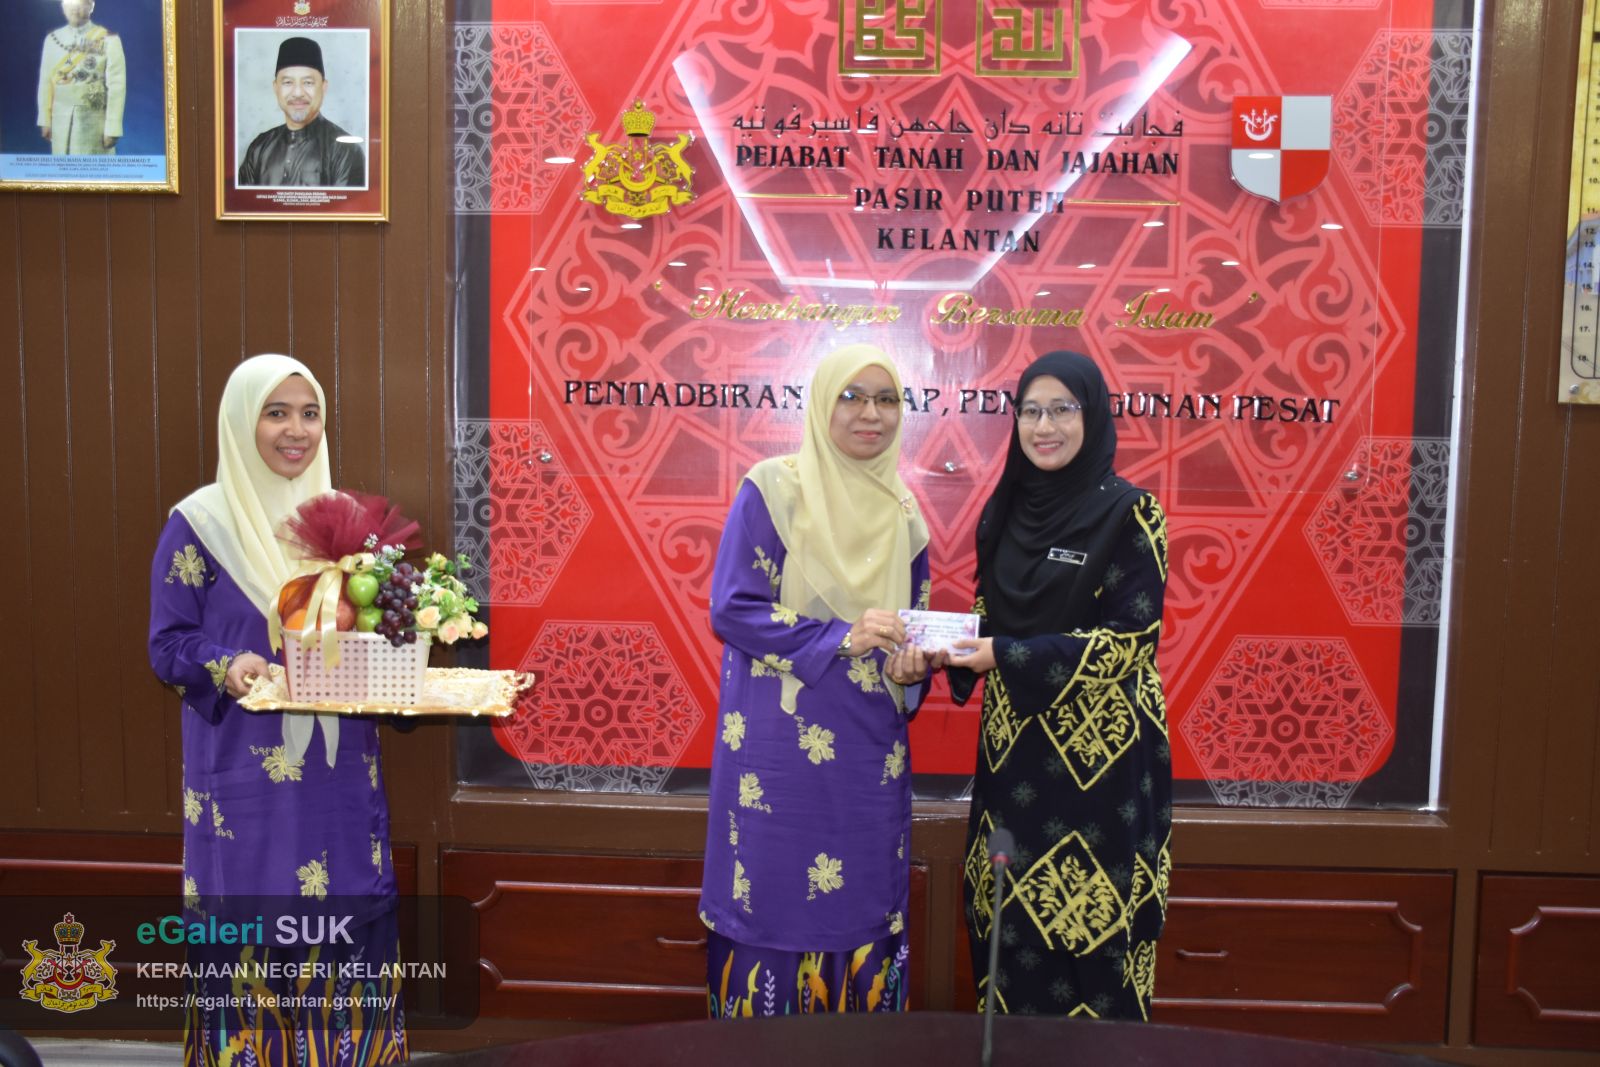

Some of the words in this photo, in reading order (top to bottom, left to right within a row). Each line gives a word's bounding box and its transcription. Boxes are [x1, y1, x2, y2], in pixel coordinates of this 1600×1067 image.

[736, 145, 850, 168] PEJABAT
[874, 147, 964, 170] TANAH
[986, 149, 1041, 172] DAN
[1060, 151, 1180, 174] JAJAHAN
[853, 187, 943, 211] PASIR
[966, 189, 1064, 214] PUTEH
[877, 227, 1042, 254] KELANTAN
[689, 287, 902, 330] Membangun
[930, 291, 1085, 326] Bersama
[1114, 290, 1217, 329] Islam
[563, 379, 804, 411] PENTADBIRAN
[959, 387, 1221, 421] PEMGUNAN
[1233, 394, 1341, 424] PESAT
